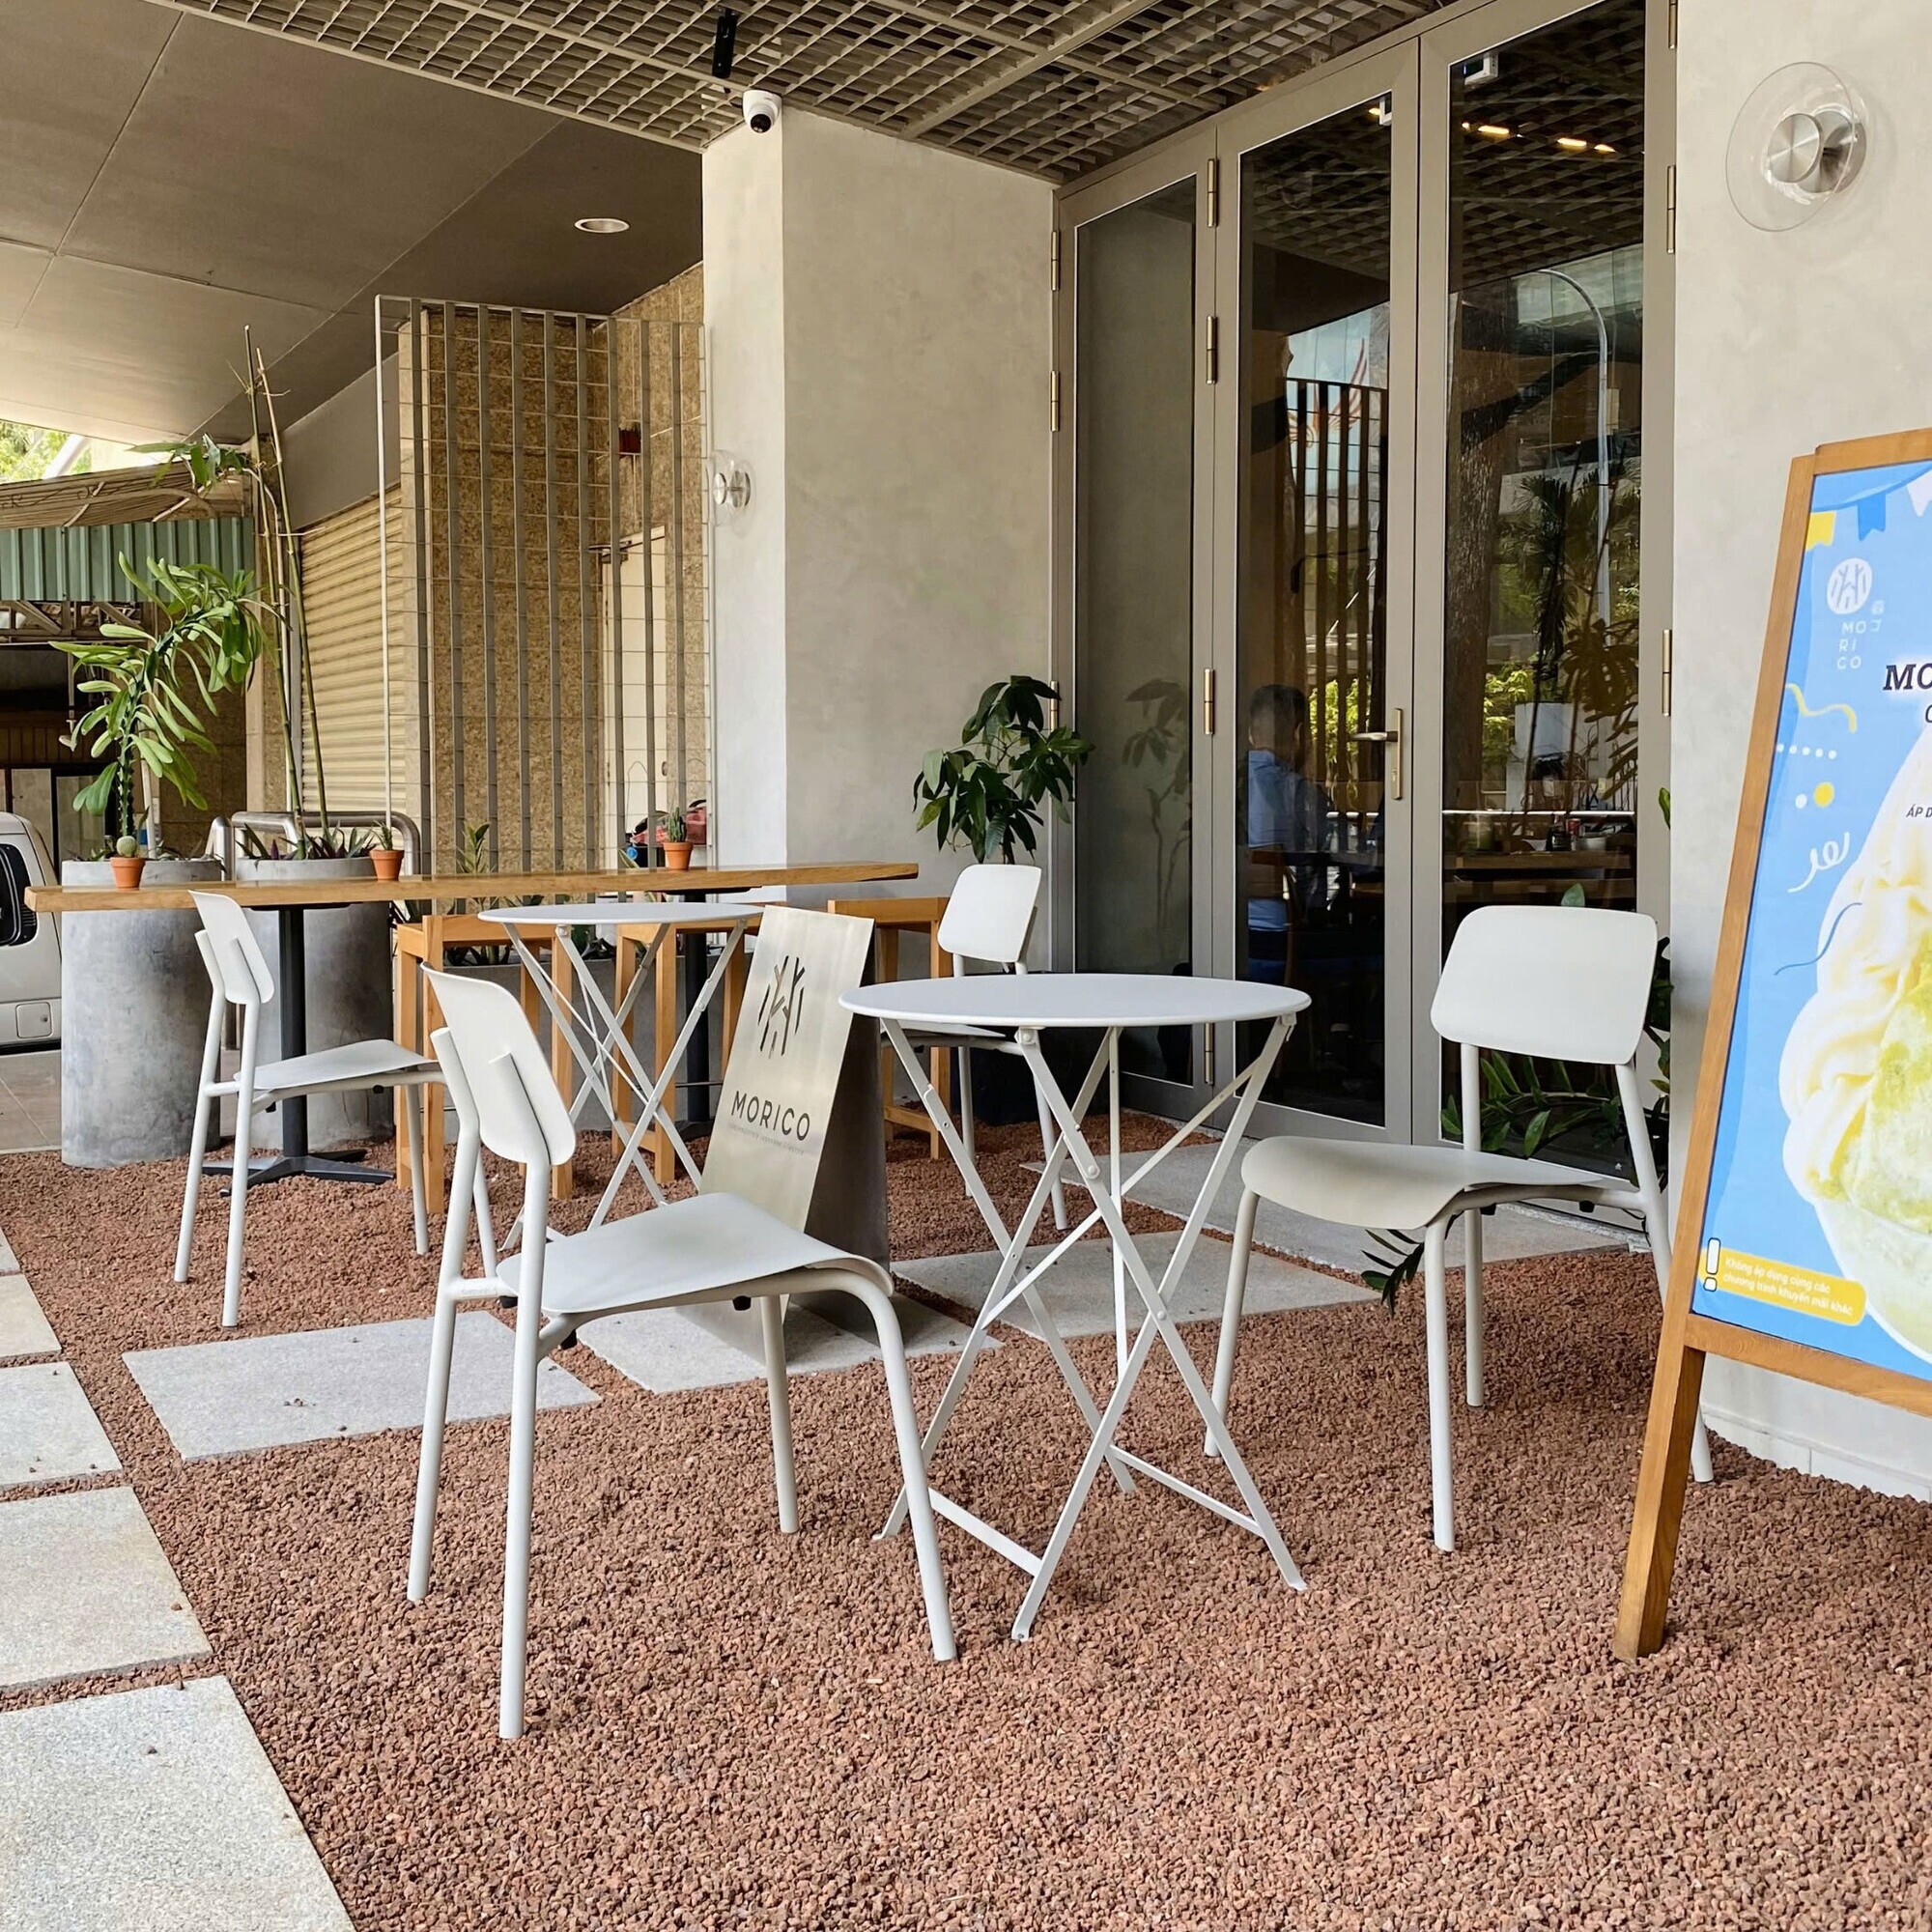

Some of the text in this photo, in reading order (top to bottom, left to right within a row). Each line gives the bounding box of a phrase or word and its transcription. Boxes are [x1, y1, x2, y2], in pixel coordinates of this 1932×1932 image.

[1842, 620, 1866, 635] MO
[1839, 638, 1857, 653] RI
[1836, 656, 1861, 669] CO
[1906, 804, 1923, 818] ÁP
[731, 1091, 810, 1141] MORICO
